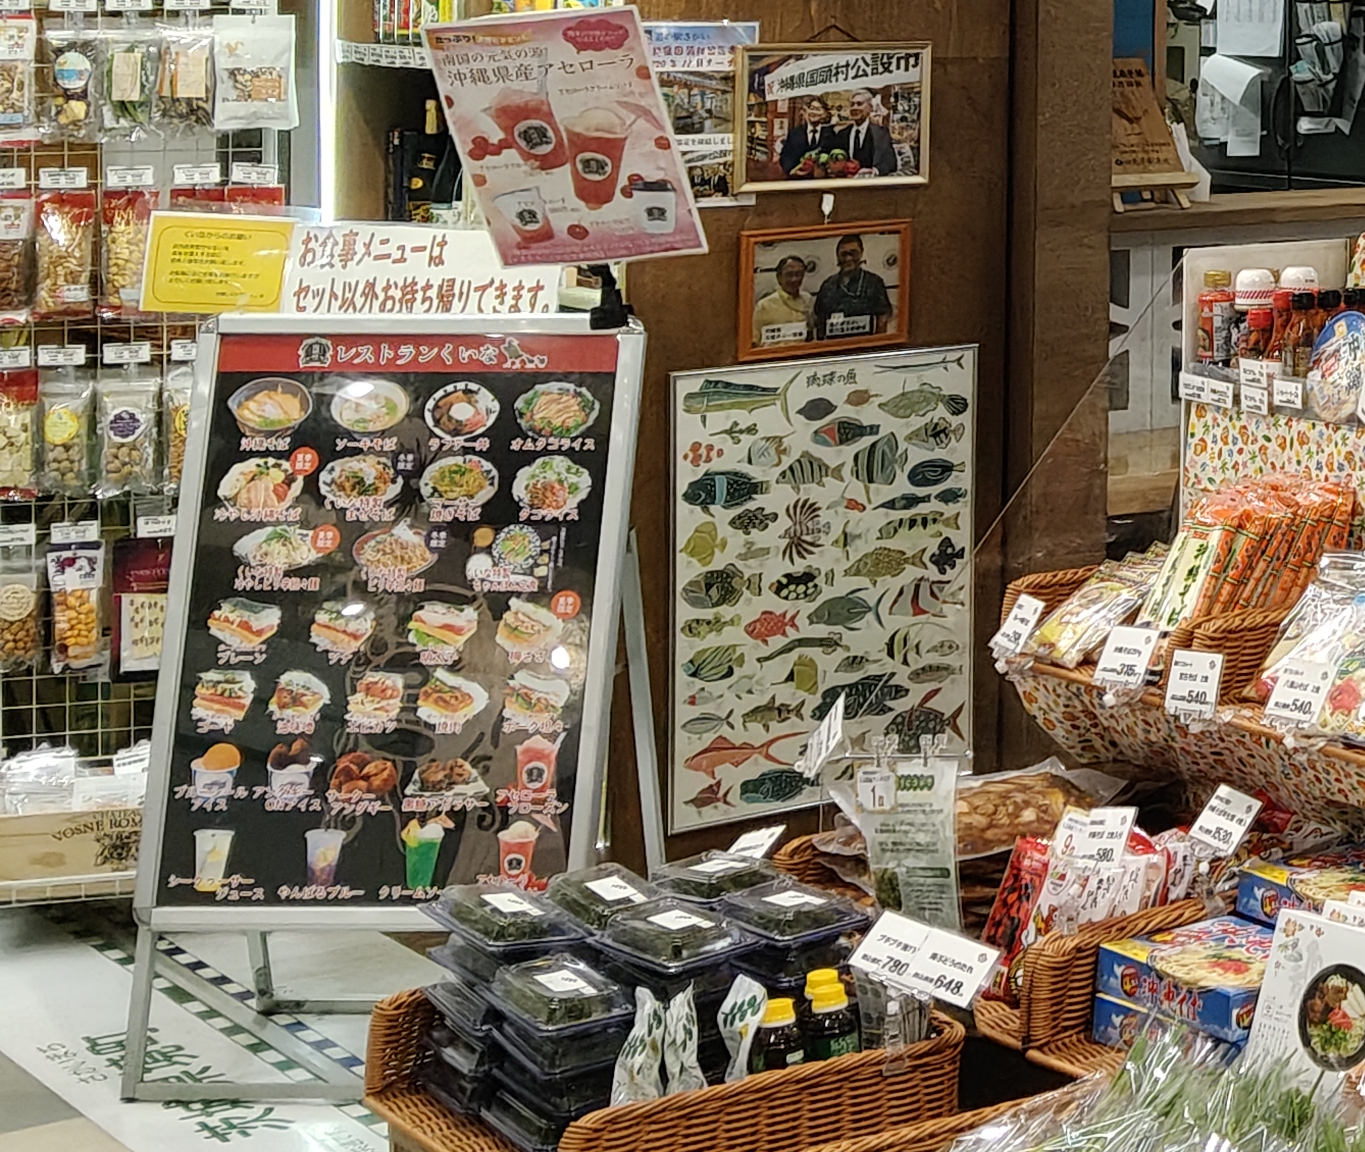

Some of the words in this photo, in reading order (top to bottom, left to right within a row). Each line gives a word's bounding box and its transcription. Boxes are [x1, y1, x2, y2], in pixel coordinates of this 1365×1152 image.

[298, 229, 449, 270] お食事メニューは
[293, 277, 553, 316] セット以外お持ち帰りできます。
[336, 339, 500, 367] レストランくいな
